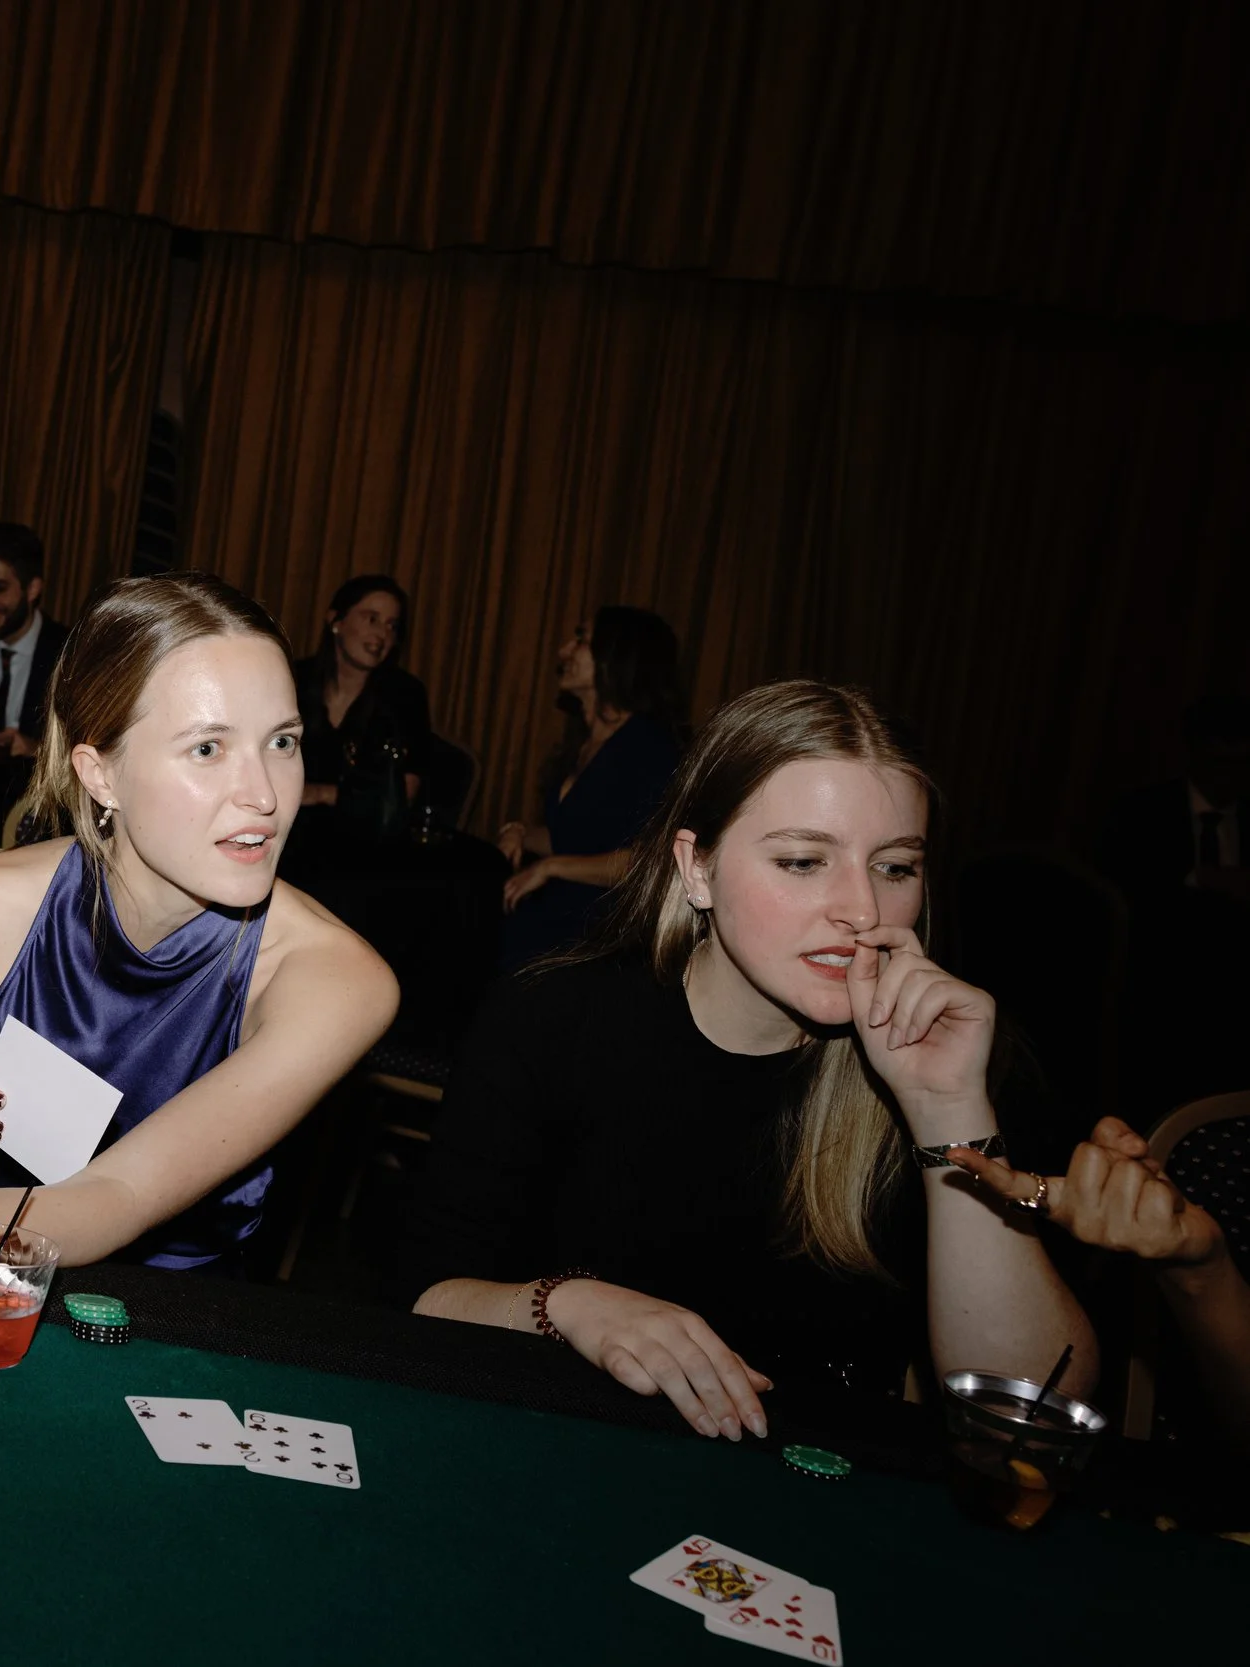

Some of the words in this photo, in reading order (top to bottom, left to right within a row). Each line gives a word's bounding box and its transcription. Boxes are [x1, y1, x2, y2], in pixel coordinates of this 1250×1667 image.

[132, 1399, 150, 1411] 2
[249, 1413, 266, 1424] 6
[240, 1450, 261, 1463] 2
[812, 1644, 837, 1662] 10
